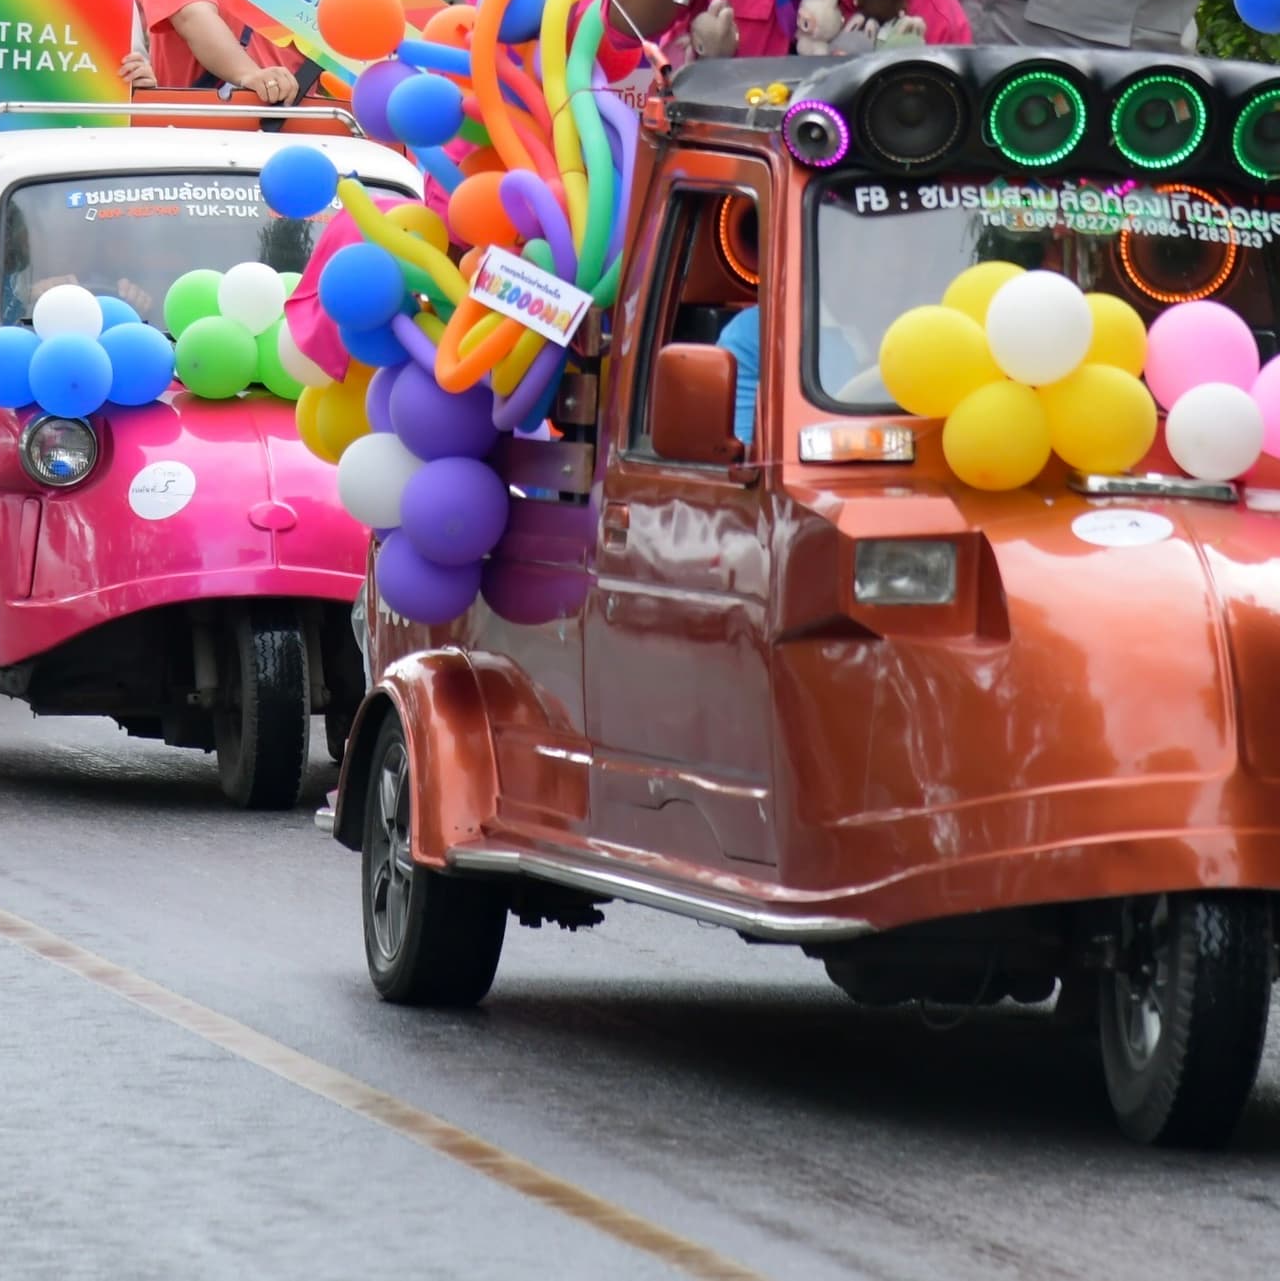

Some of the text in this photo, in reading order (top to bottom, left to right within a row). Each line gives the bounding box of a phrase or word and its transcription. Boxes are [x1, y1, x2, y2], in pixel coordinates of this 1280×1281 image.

[854, 185, 890, 213] FB
[185, 203, 260, 219] TUK-TUK
[979, 209, 1007, 228] Tel
